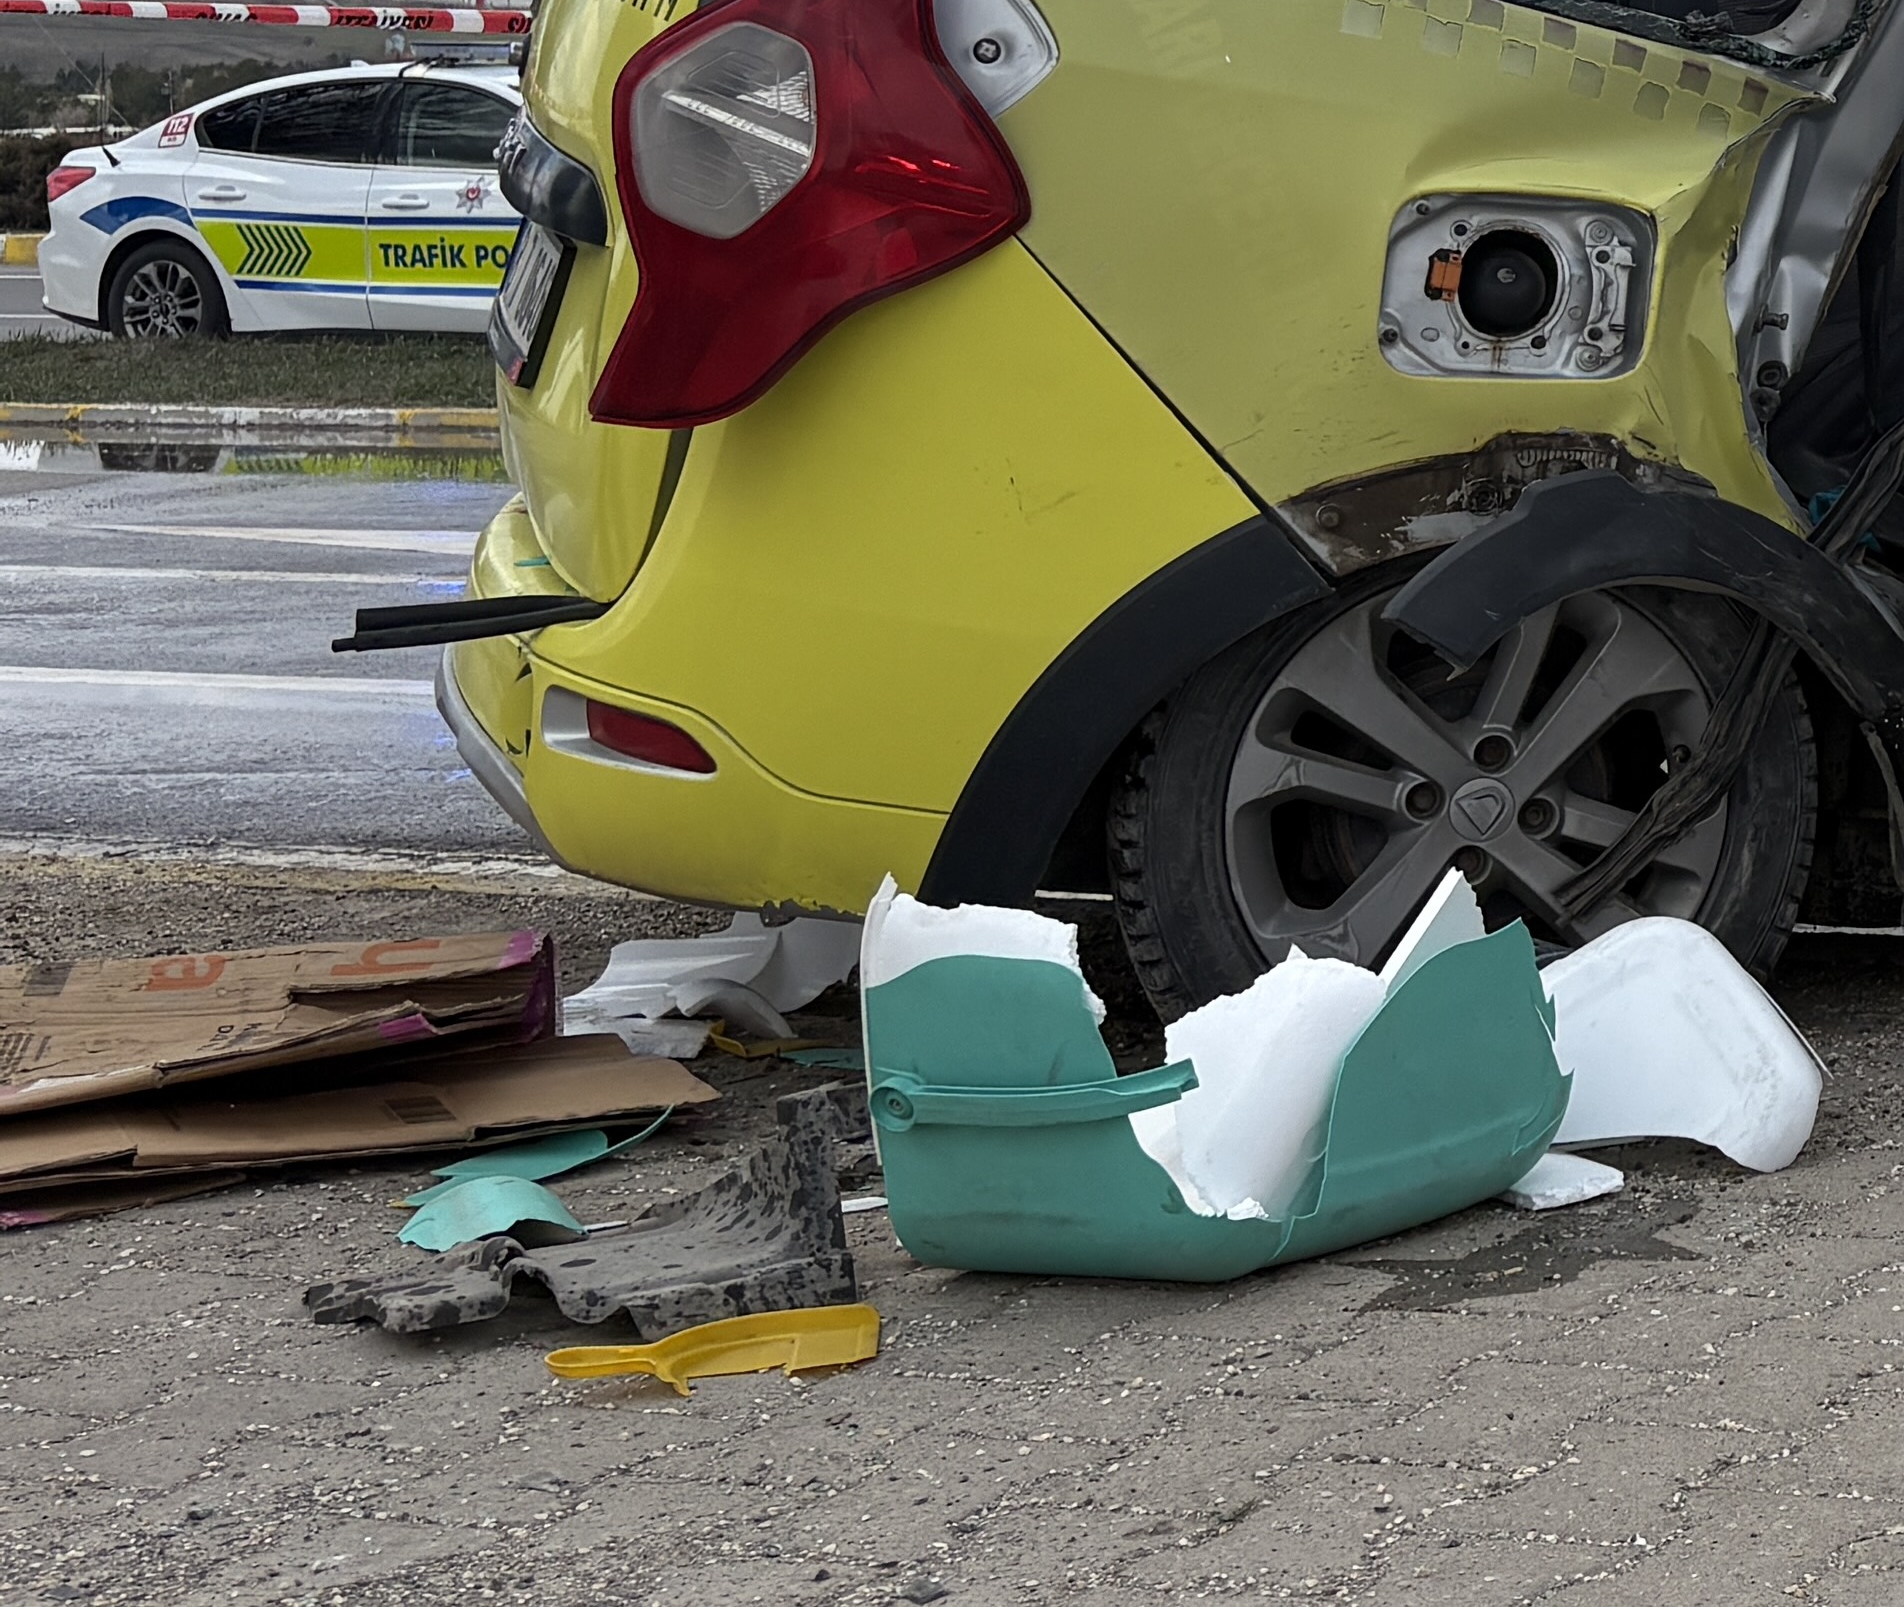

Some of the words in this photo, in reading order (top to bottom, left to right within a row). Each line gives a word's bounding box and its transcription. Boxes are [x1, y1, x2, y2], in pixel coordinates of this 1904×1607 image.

[167, 116, 190, 134] 112
[378, 236, 468, 269] TRAFİK
[474, 244, 509, 269] PO
